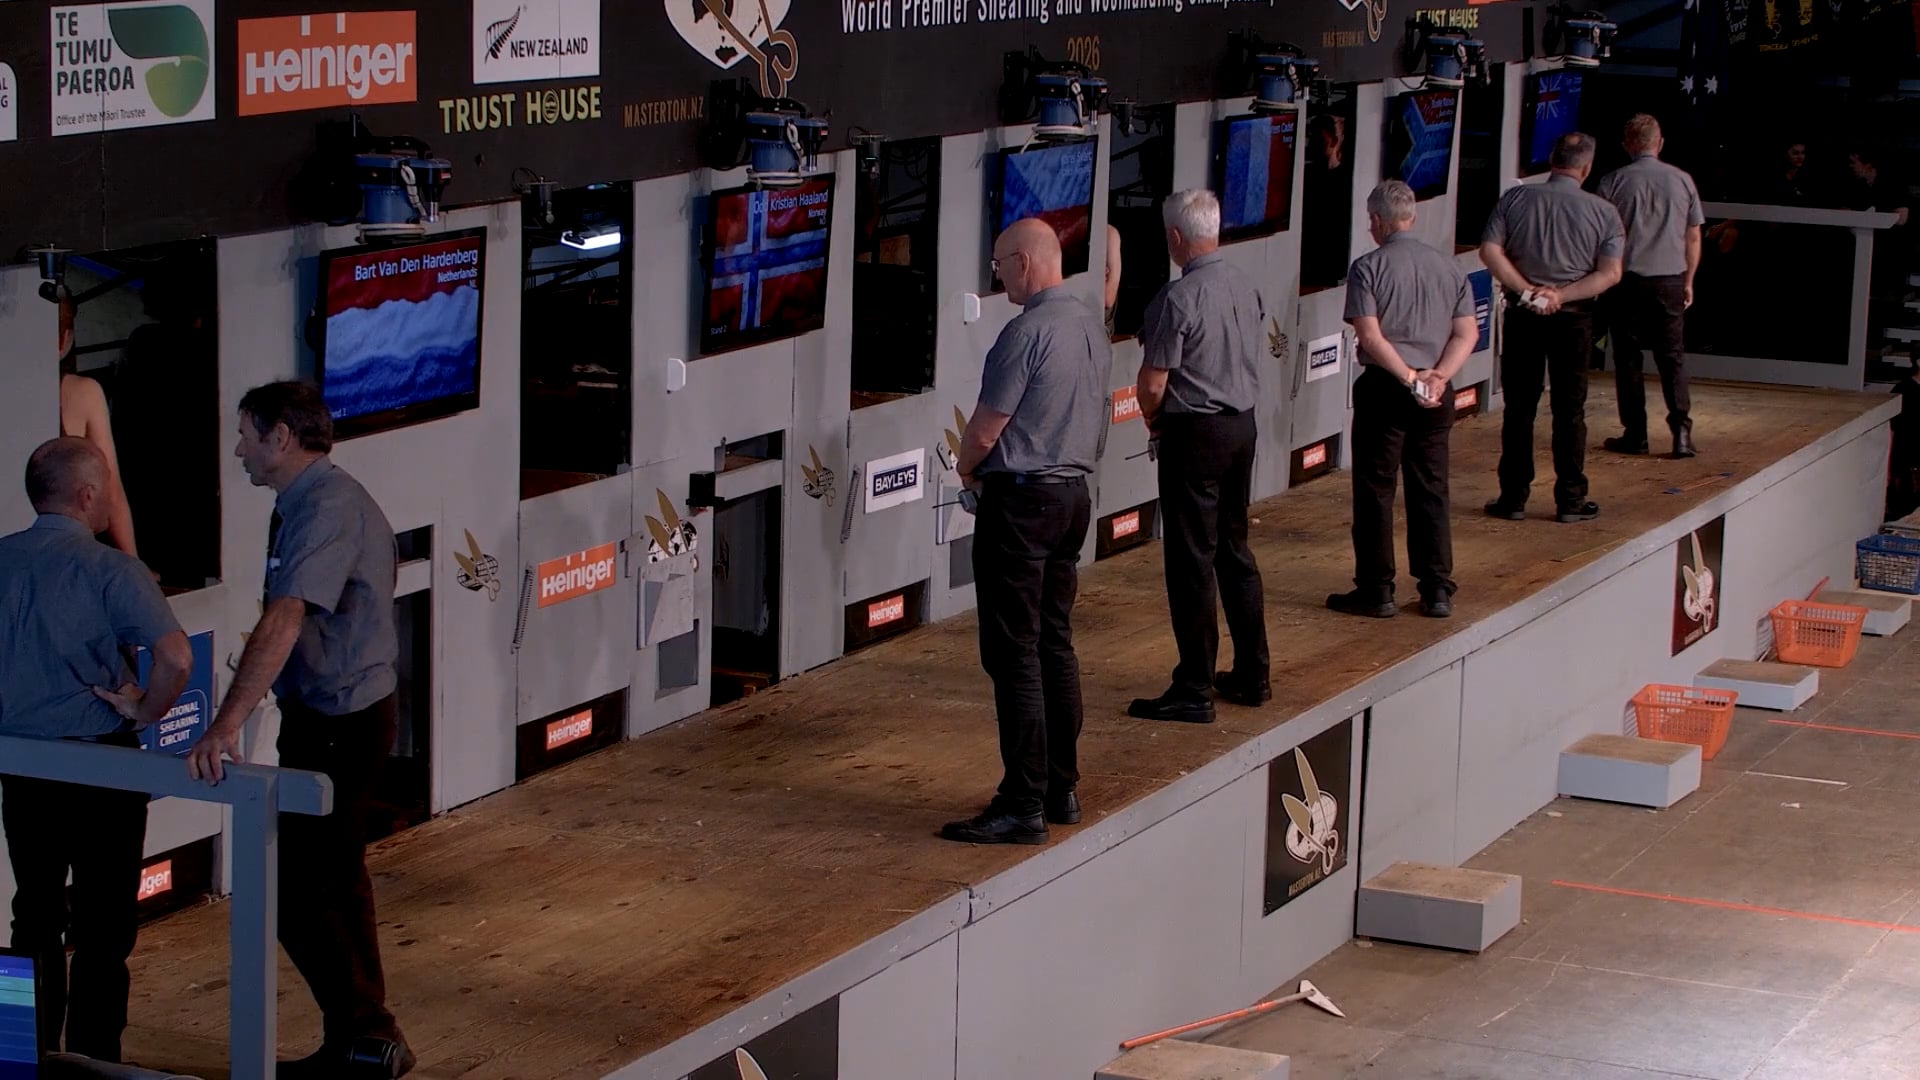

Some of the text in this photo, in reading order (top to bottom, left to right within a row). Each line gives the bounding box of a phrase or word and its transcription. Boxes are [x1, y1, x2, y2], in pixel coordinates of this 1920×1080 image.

[55, 12, 79, 37] TE
[841, 0, 892, 34] World
[900, 0, 969, 29] Premier
[977, 0, 1049, 24] Shearing
[1056, 0, 1083, 15] and
[1415, 8, 1479, 28] TUST HOUSE
[55, 38, 112, 66] TUMU
[245, 13, 413, 99] Heiniger
[510, 37, 588, 58] NEW ZEALAND
[1066, 35, 1101, 71] 2026
[56, 66, 135, 96] PAEROA
[56, 114, 76, 127] Office
[78, 113, 86, 125] of
[86, 112, 98, 123] the
[120, 108, 146, 120] Trustee
[439, 86, 602, 134] TRUST HOUSE
[624, 95, 704, 128] MASTERTON.NZ
[753, 189, 829, 213] Od Kristian Haaland
[807, 208, 827, 219] Norway
[354, 249, 479, 281] Bart Van Den Hardenberg
[437, 267, 478, 284] Netherlands
[875, 468, 916, 493] BAYLEYS
[542, 551, 615, 598] Heiniger
[160, 713, 200, 734] SHEARING
[548, 715, 592, 744] Heiniger
[160, 729, 192, 748] CIRCUIT
[139, 868, 171, 895] iger
